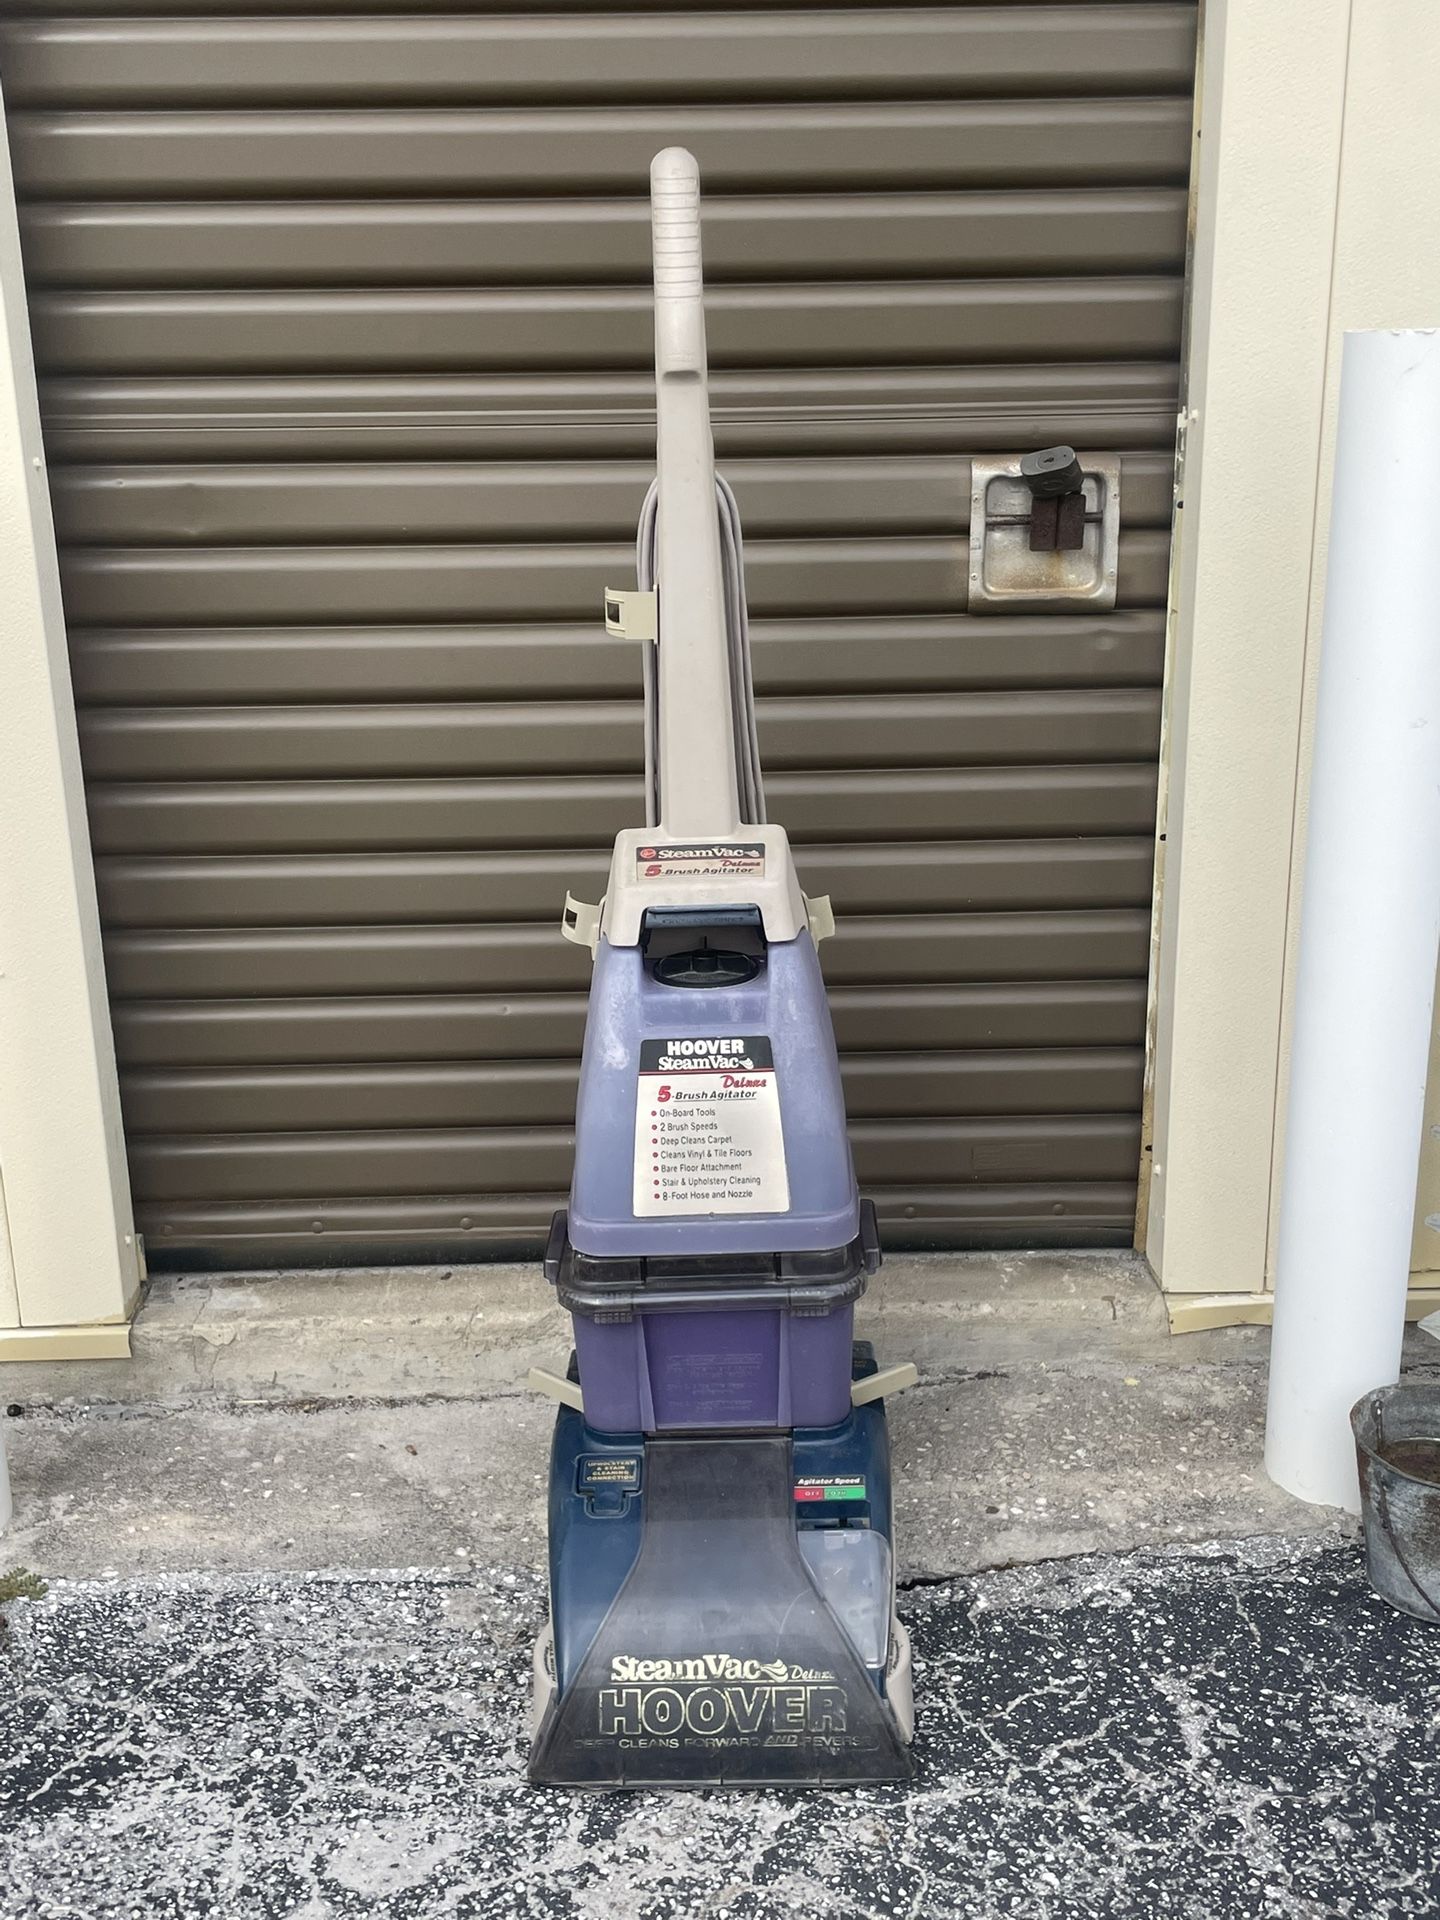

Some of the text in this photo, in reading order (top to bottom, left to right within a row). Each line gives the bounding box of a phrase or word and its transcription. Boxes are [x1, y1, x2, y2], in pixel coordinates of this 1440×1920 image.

[658, 847, 744, 859] SteamVac
[702, 866, 754, 875] Agitator
[667, 1039, 744, 1056] HOOVER
[658, 1054, 740, 1071] SteamVac
[720, 1074, 767, 1089] Deluxe
[657, 1085, 757, 1102] 5-Brush Agitator
[660, 1108, 716, 1118] On-Board Tools
[660, 1122, 718, 1132] 2 Brush Speeds
[660, 1135, 732, 1146] Deep Cleans Carpet
[660, 1149, 752, 1160] Cleans Vinyl & Tile Floors
[661, 1162, 742, 1173] Bare Floor Attachment
[662, 1175, 761, 1187] Stair & Upholstery Cleaning
[662, 1190, 753, 1201] 8-Foot Hose and Nozzle
[797, 1477, 861, 1486] Agitator Speed
[611, 1654, 761, 1682] SteamVac
[599, 1686, 847, 1735] HOOVER
[618, 1738, 680, 1749] CLEANS
[684, 1738, 761, 1748] FORWARD
[764, 1735, 799, 1746] AND
